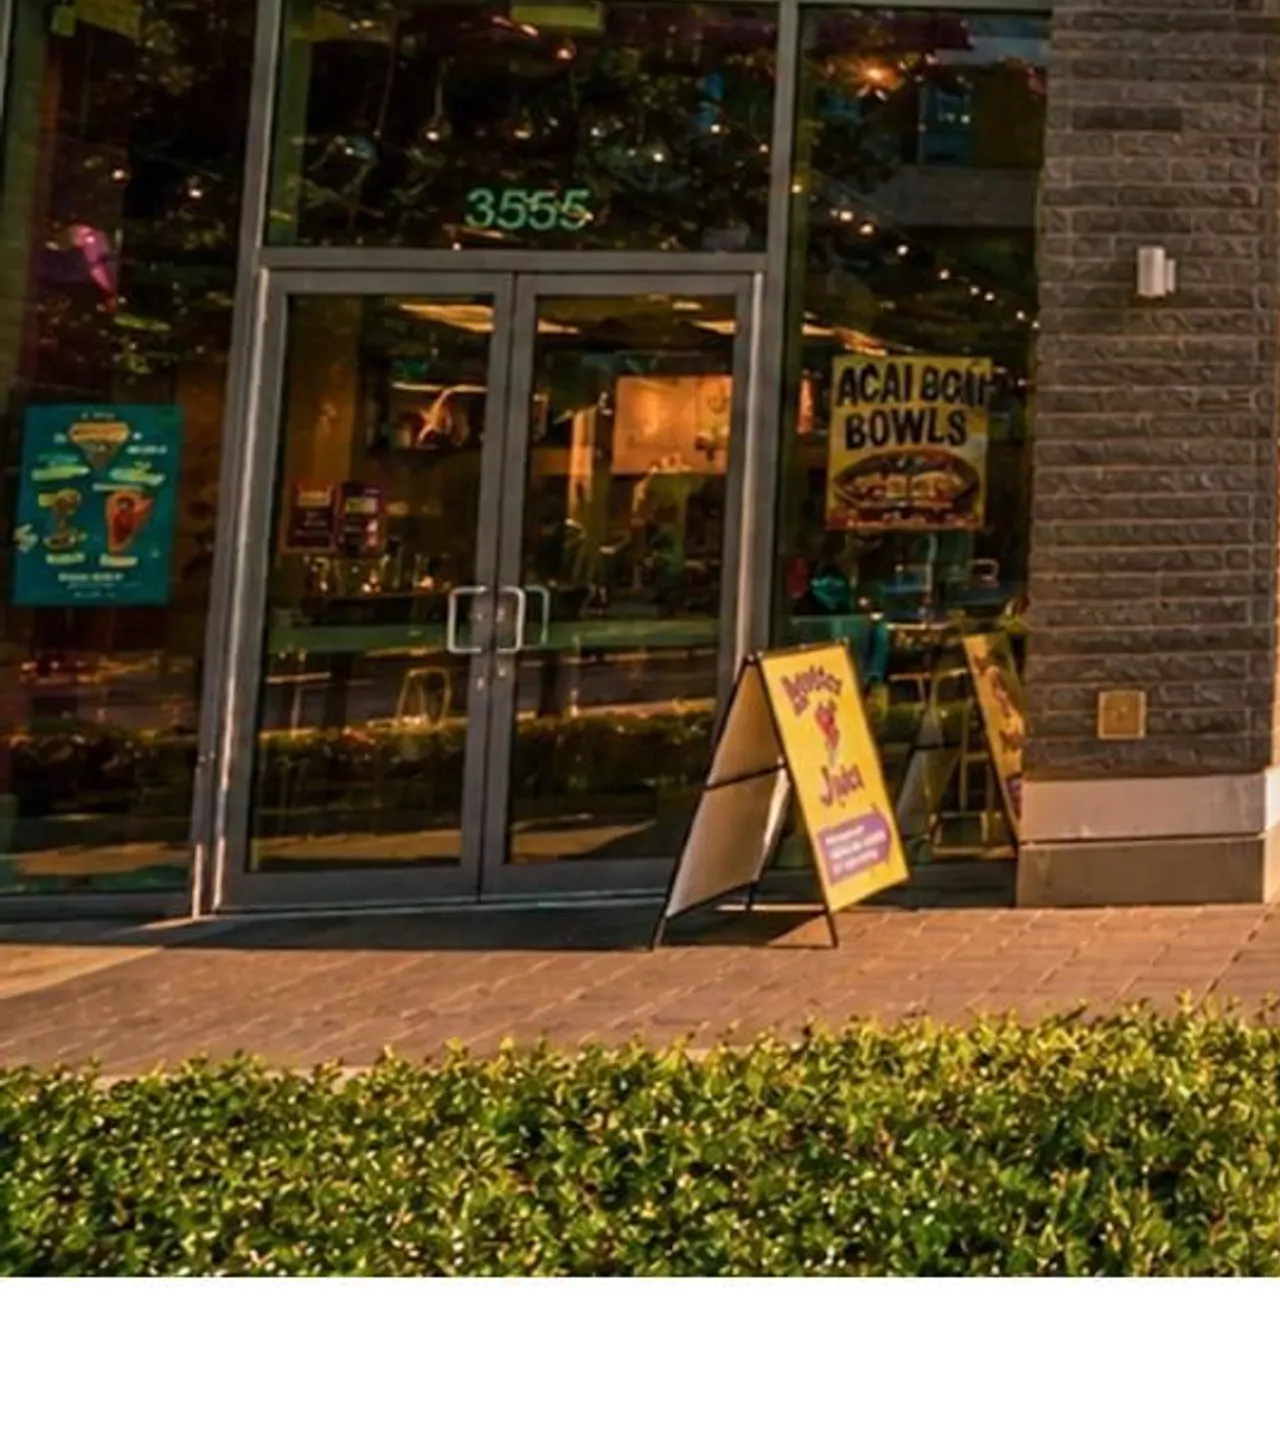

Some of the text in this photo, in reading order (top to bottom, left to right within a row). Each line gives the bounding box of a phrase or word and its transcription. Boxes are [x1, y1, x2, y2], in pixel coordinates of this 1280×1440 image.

[464, 186, 590, 231] 3555
[834, 362, 914, 407] ACAI
[844, 408, 967, 451] BOWLS
